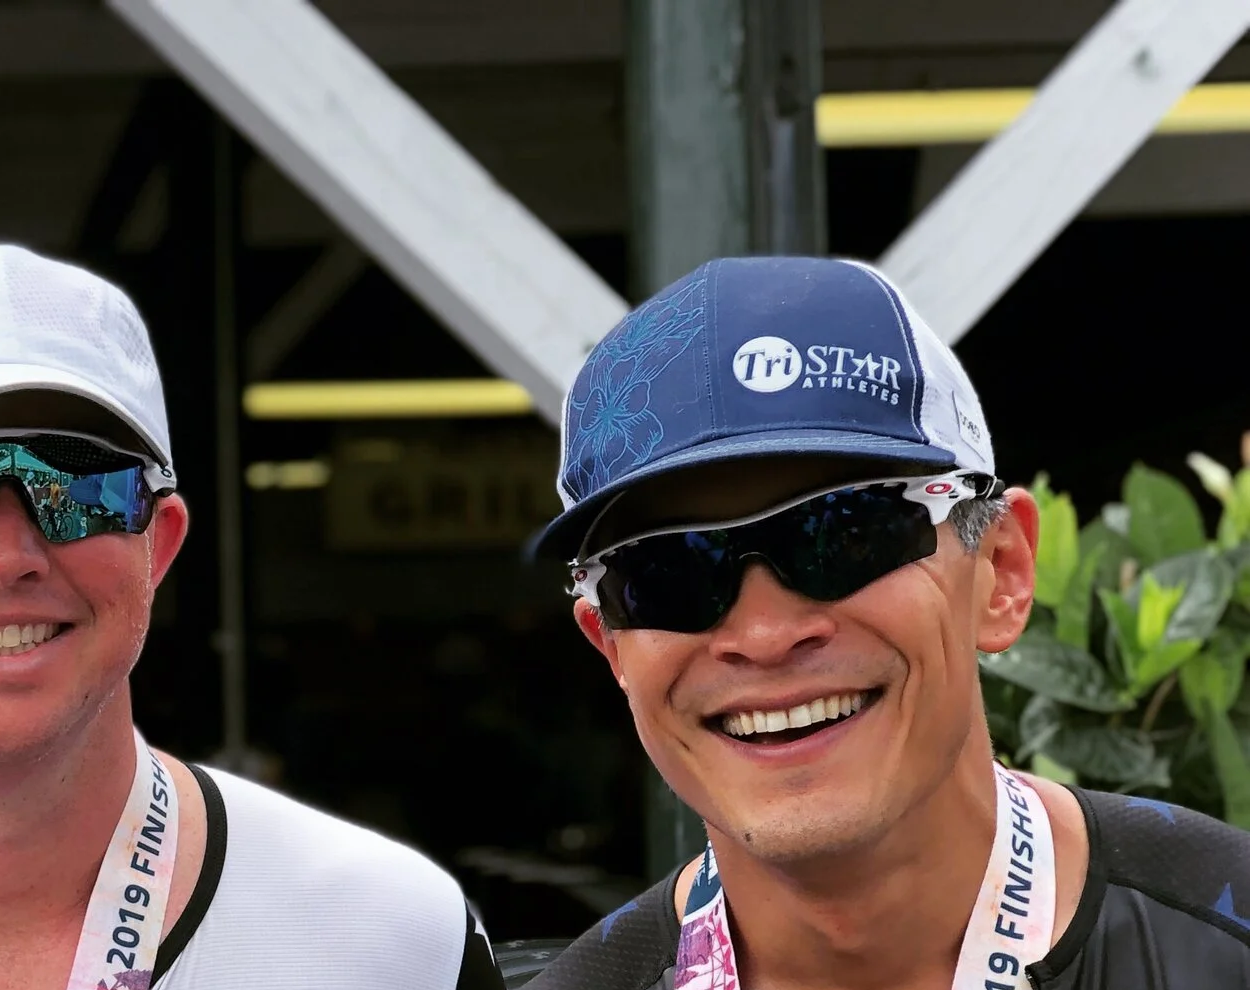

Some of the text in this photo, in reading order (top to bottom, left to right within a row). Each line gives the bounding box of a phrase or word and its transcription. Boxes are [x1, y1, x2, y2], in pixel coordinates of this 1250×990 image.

[738, 345, 901, 391] Tri STAR
[802, 376, 900, 406] ATHLETES
[106, 884, 151, 970] 2019
